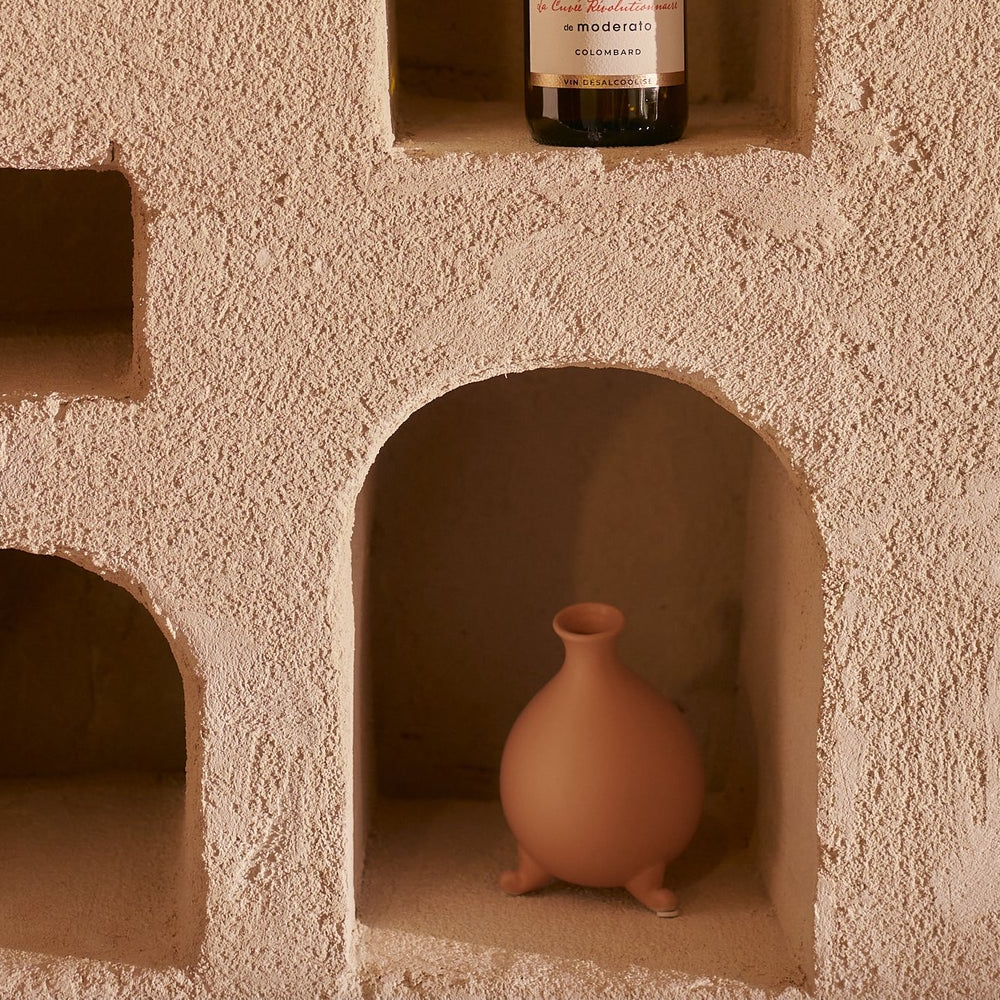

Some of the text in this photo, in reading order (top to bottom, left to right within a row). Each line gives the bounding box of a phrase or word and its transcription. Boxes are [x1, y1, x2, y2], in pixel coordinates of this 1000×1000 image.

[564, 21, 652, 32] de moderato
[575, 48, 642, 56] COLOMBARD
[564, 78, 579, 86] VIN
